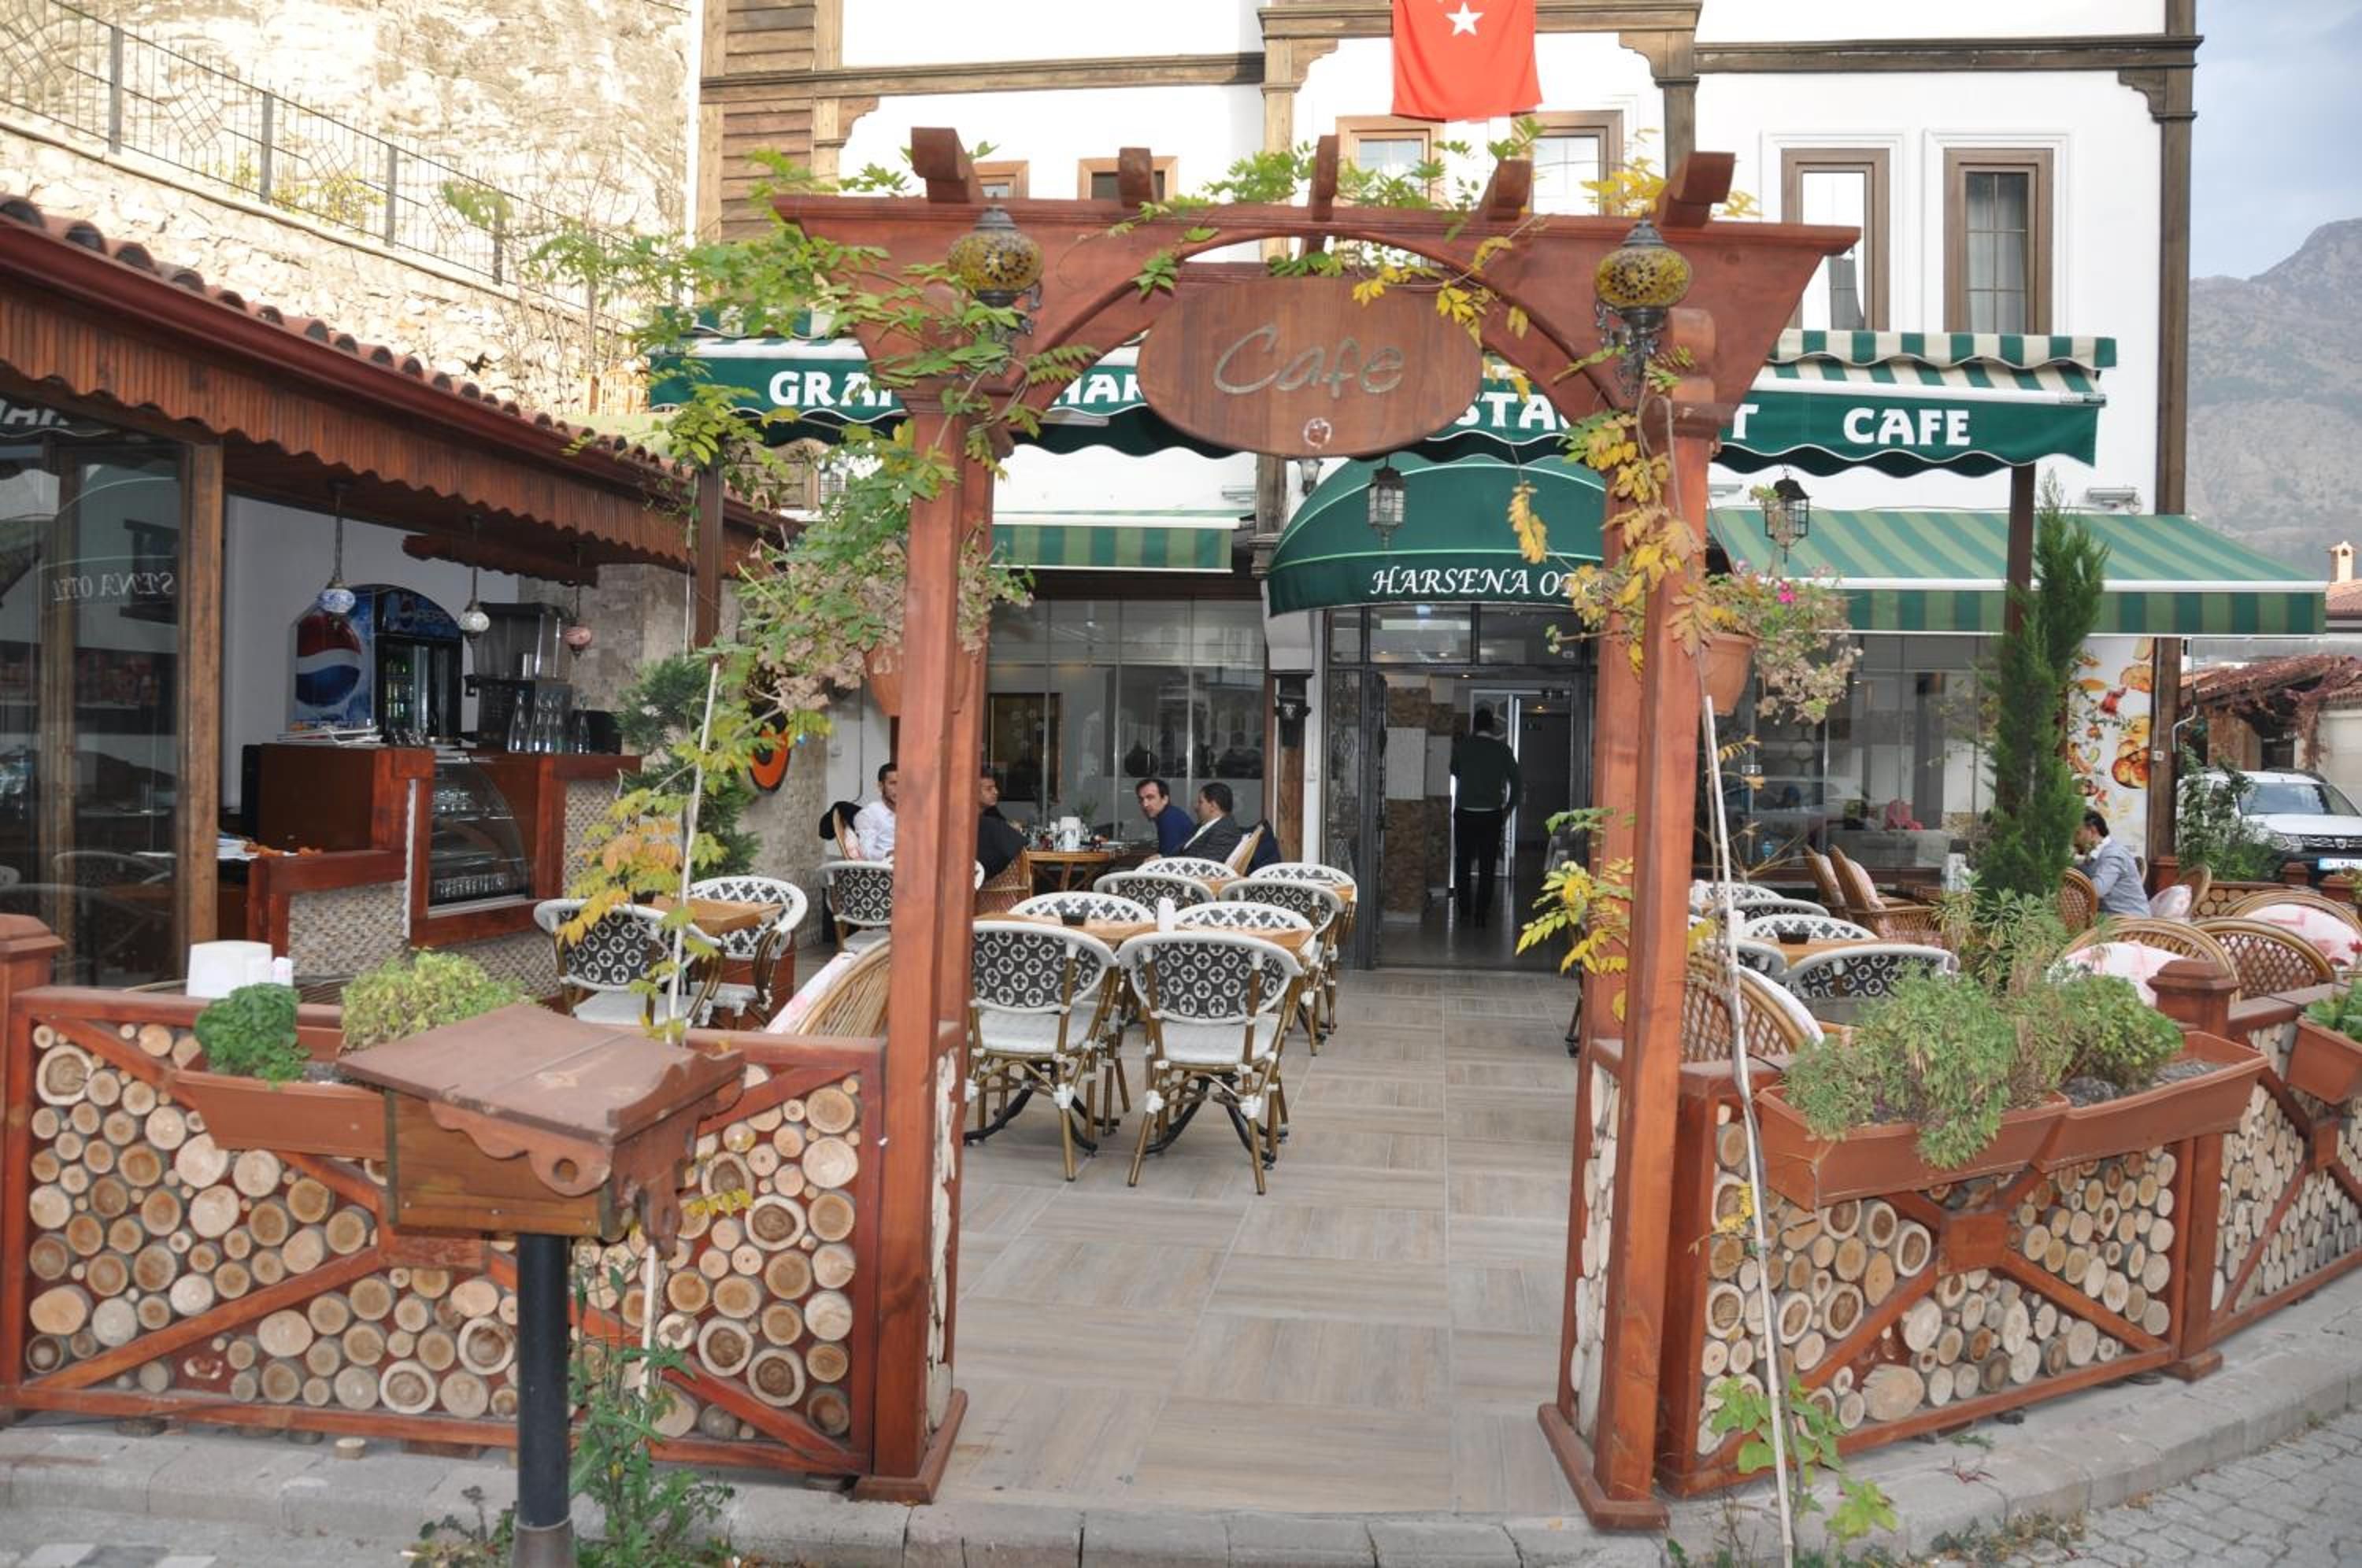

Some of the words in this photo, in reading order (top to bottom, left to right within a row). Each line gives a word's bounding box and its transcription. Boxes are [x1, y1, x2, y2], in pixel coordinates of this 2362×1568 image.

[1213, 323, 1405, 400] Cafe
[1842, 407, 1971, 446] CAFE
[1370, 566, 1531, 595] HARSENA
